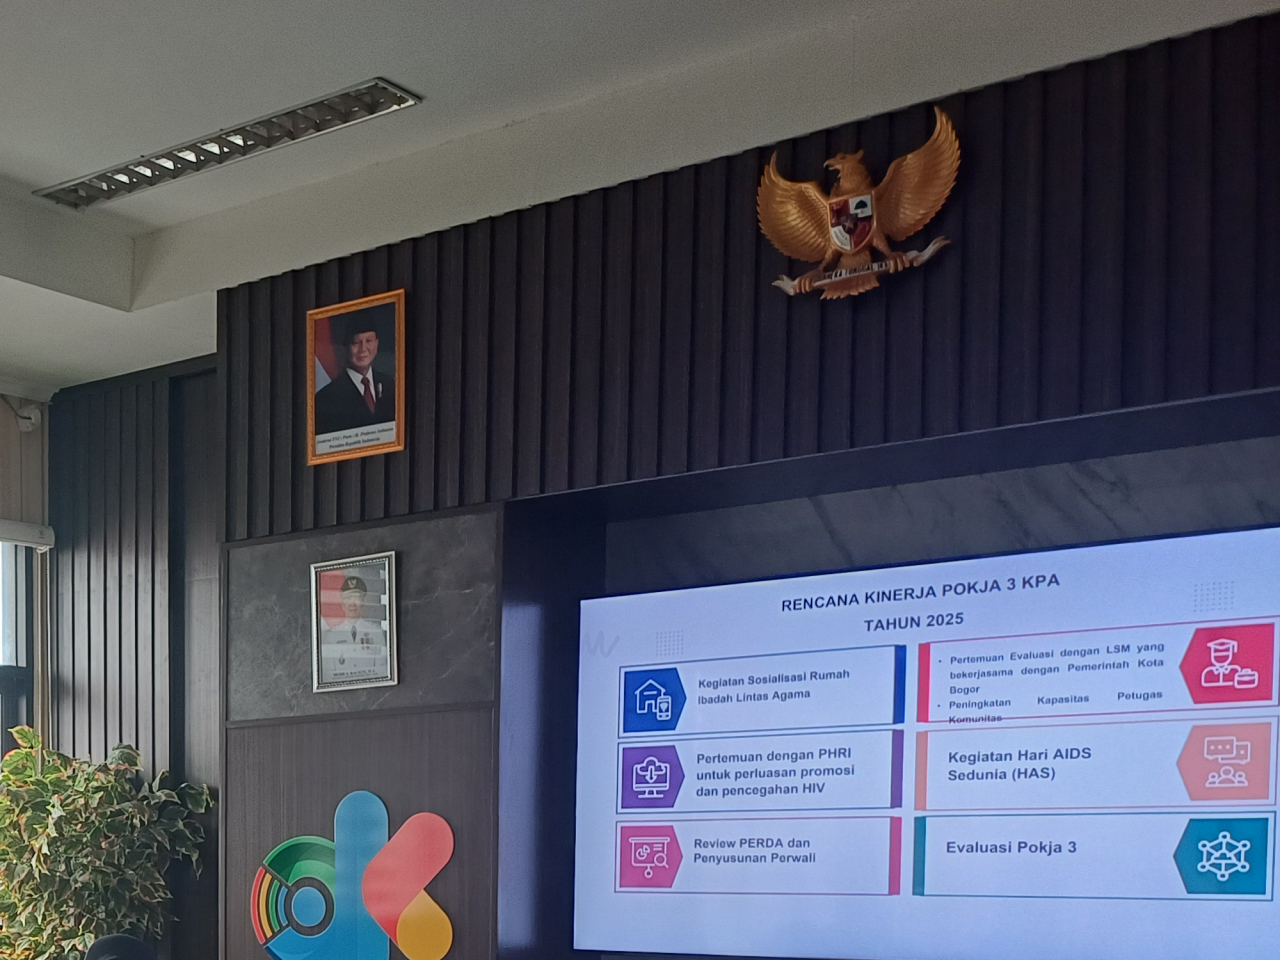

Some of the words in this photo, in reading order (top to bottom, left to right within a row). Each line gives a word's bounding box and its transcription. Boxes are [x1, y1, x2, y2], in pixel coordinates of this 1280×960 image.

[782, 594, 859, 612] RENCANA
[864, 586, 937, 604] KINERJA
[942, 579, 1001, 597] POKJA
[1007, 578, 1016, 591] 3
[1021, 573, 1060, 589] KPA
[864, 616, 920, 632] TAHUN
[926, 612, 964, 627] 2025
[950, 653, 1004, 665] Pertemuan
[1010, 650, 1054, 661] Evaluasi
[1060, 646, 1100, 659] dengan
[1106, 644, 1131, 654] LSM
[1136, 643, 1165, 654] yang
[949, 668, 1013, 680] bekerjasama
[1021, 665, 1060, 677] dengan
[1067, 660, 1130, 673] Pemerintah
[1138, 658, 1164, 668] Kota
[698, 677, 745, 690] Kegiatan
[747, 671, 807, 685] Sosialisasi
[810, 669, 850, 681] Rumah
[698, 692, 733, 705] Ibadah
[736, 691, 769, 702] Lintas
[772, 690, 811, 702] Agama
[949, 685, 980, 696] Bogor
[949, 698, 1011, 710] Peningkatan
[1037, 694, 1090, 706] Kapasitas
[1117, 690, 1163, 702] Petugas
[948, 714, 1003, 724] Komunitas
[696, 752, 763, 764] Pertemuan
[766, 750, 814, 763] dengan
[818, 747, 852, 759] PHRI
[948, 750, 1013, 765] Kegiatan
[1018, 749, 1048, 761] Hari
[1052, 747, 1092, 760] AIDS
[696, 769, 731, 780] untuk
[734, 767, 796, 781] perluasan
[801, 764, 855, 779] promosi
[948, 768, 1007, 781] Sedunia
[1011, 767, 1056, 782] (HAS)
[696, 786, 718, 797] dan
[722, 784, 798, 798] pencegahan
[802, 782, 826, 793] HIV
[694, 838, 736, 849] Review
[739, 838, 784, 848] PERDA
[787, 838, 810, 848] dan
[946, 841, 1012, 853] Evaluasi
[1018, 841, 1062, 856] Pokja
[1068, 841, 1077, 853] 3
[693, 853, 767, 865] Penyusunan
[771, 852, 816, 863] Perwali
